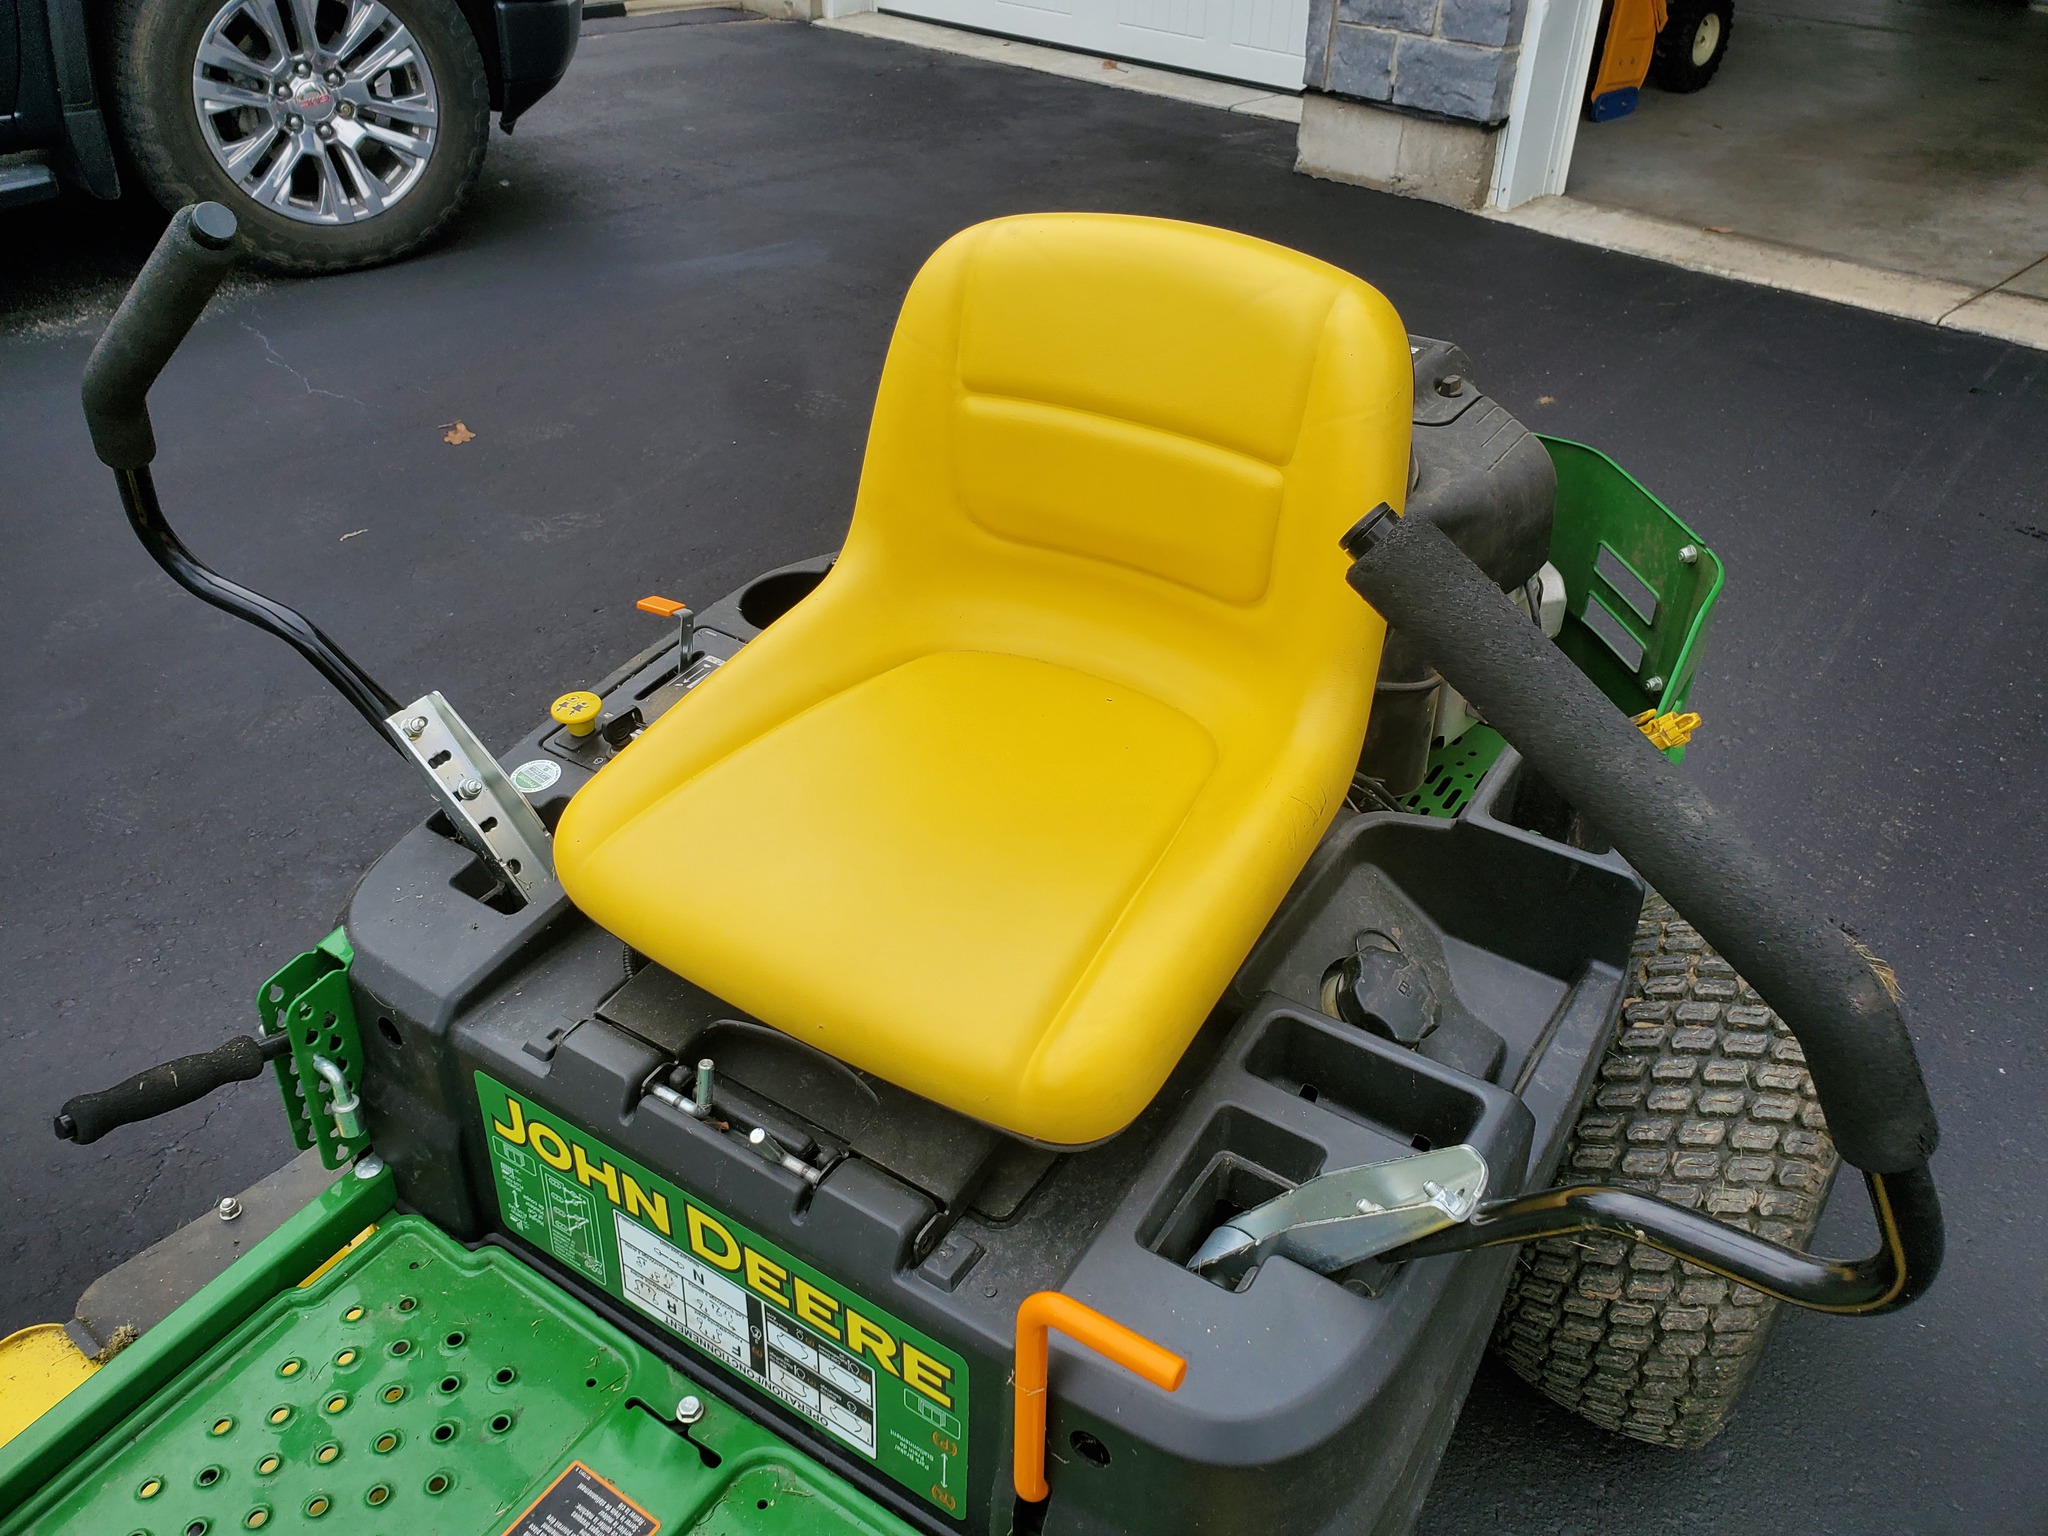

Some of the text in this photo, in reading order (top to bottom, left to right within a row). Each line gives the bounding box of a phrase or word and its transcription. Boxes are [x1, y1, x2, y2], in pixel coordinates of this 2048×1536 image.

[493, 1096, 953, 1409] JOHN DEERE
[692, 1268, 704, 1285] N
[666, 1299, 677, 1315] R
[730, 1341, 741, 1357] F
[664, 1315, 827, 1427] OPERATION/FONCTIONNEMENT
[899, 1440, 907, 1450] de
[932, 1431, 957, 1457] (P)
[916, 1457, 928, 1470] Park
[576, 1482, 607, 1507] stationnement
[930, 1483, 955, 1511] (R)
[607, 1507, 622, 1519] frein
[627, 1510, 645, 1525] Retirer
[622, 1518, 639, 1532] Serrer
